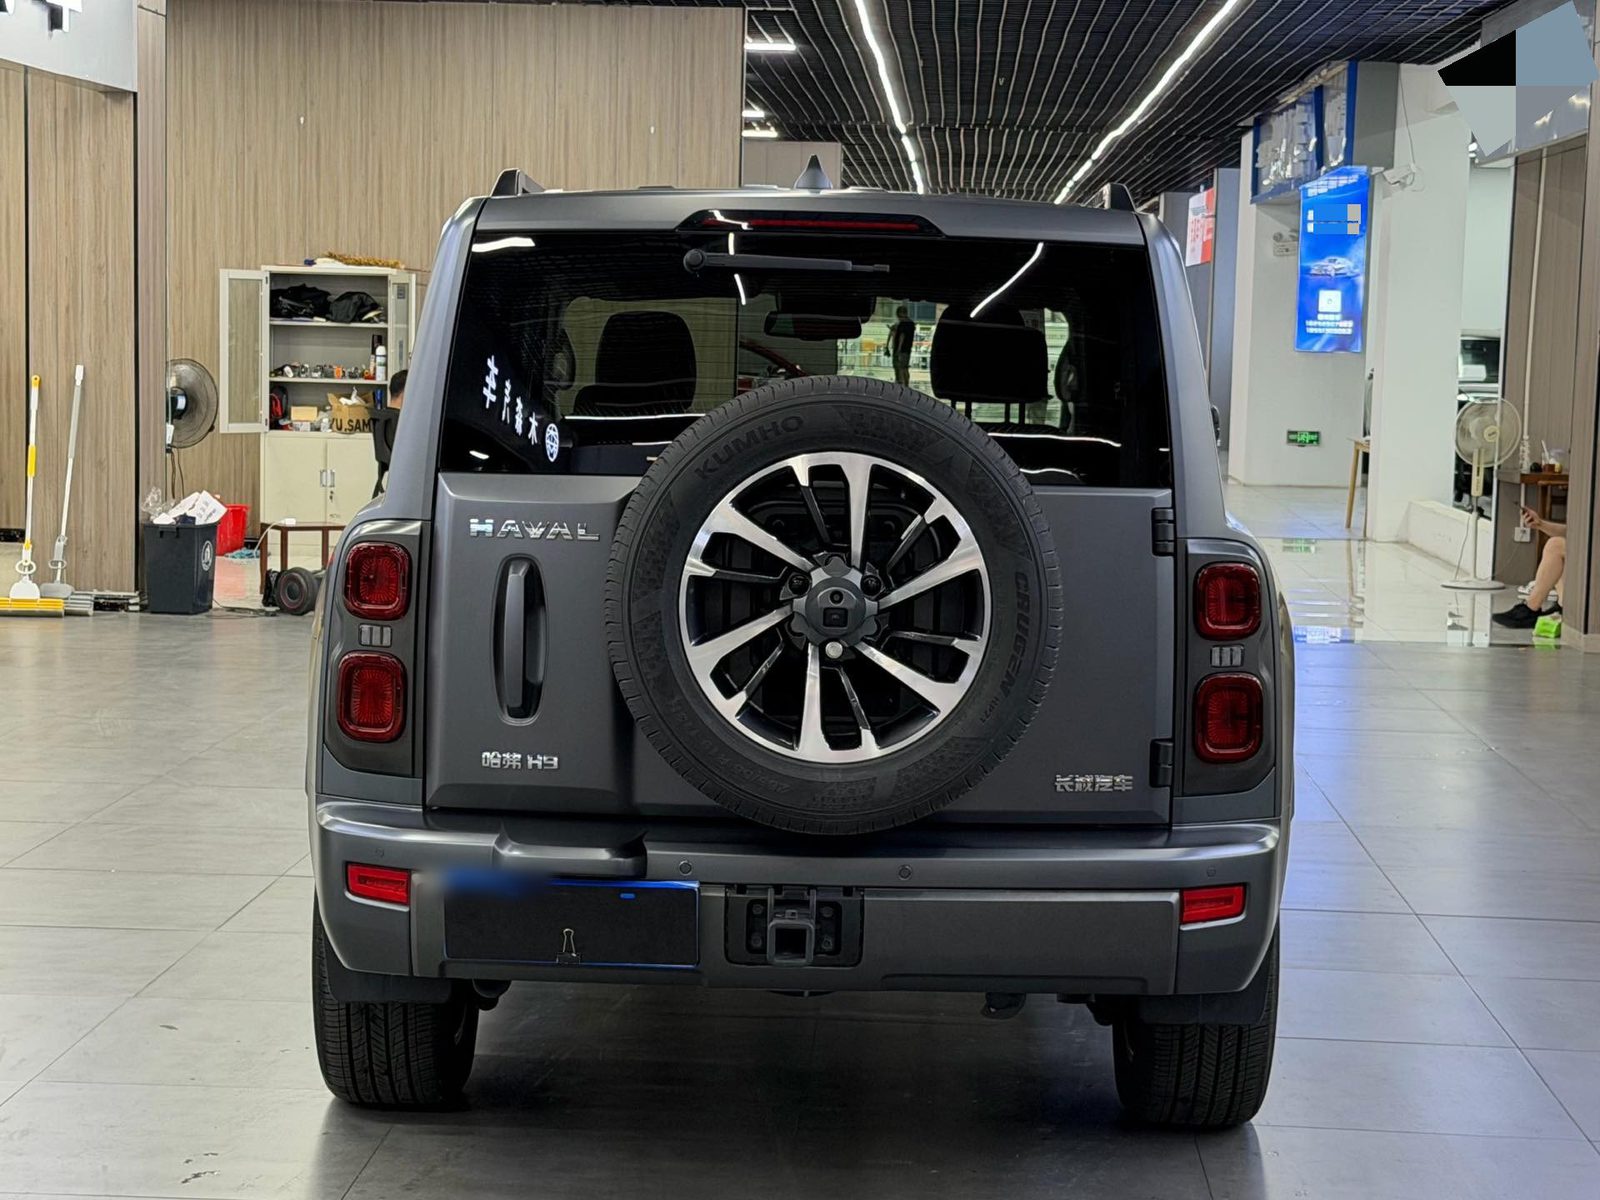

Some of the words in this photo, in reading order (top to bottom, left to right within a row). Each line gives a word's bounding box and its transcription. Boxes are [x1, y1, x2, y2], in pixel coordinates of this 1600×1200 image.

[694, 414, 805, 480] KUMHO
[469, 519, 600, 540] HAVAL
[1000, 571, 1030, 698] CRUGEN
[481, 751, 522, 769] 哈弗
[526, 754, 559, 770] H9
[1055, 774, 1133, 792] 长城汽车
